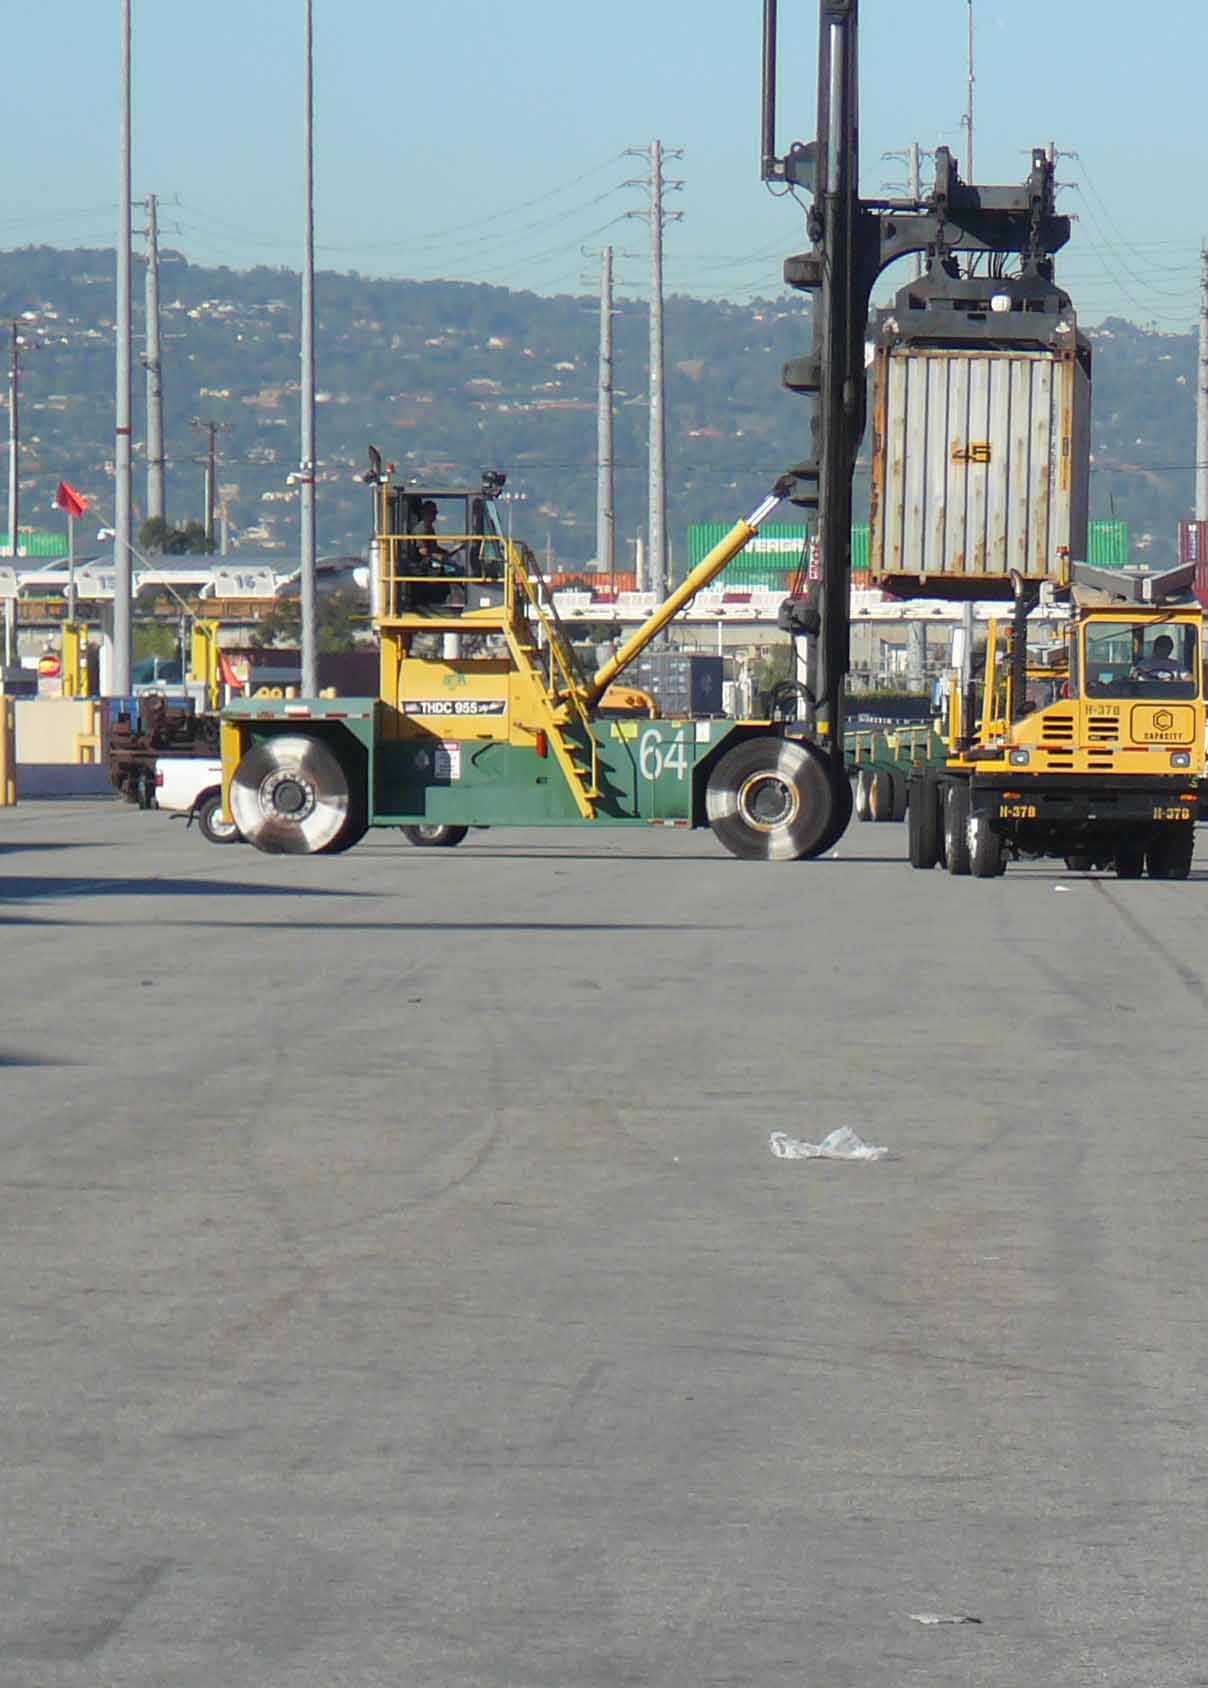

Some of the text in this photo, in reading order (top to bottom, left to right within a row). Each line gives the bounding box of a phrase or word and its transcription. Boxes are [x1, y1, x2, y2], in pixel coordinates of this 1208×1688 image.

[952, 444, 992, 463] 45
[421, 702, 452, 713] THDC
[455, 702, 478, 713] 955
[1144, 732, 1184, 741] CAPACITY
[640, 729, 688, 780] 64
